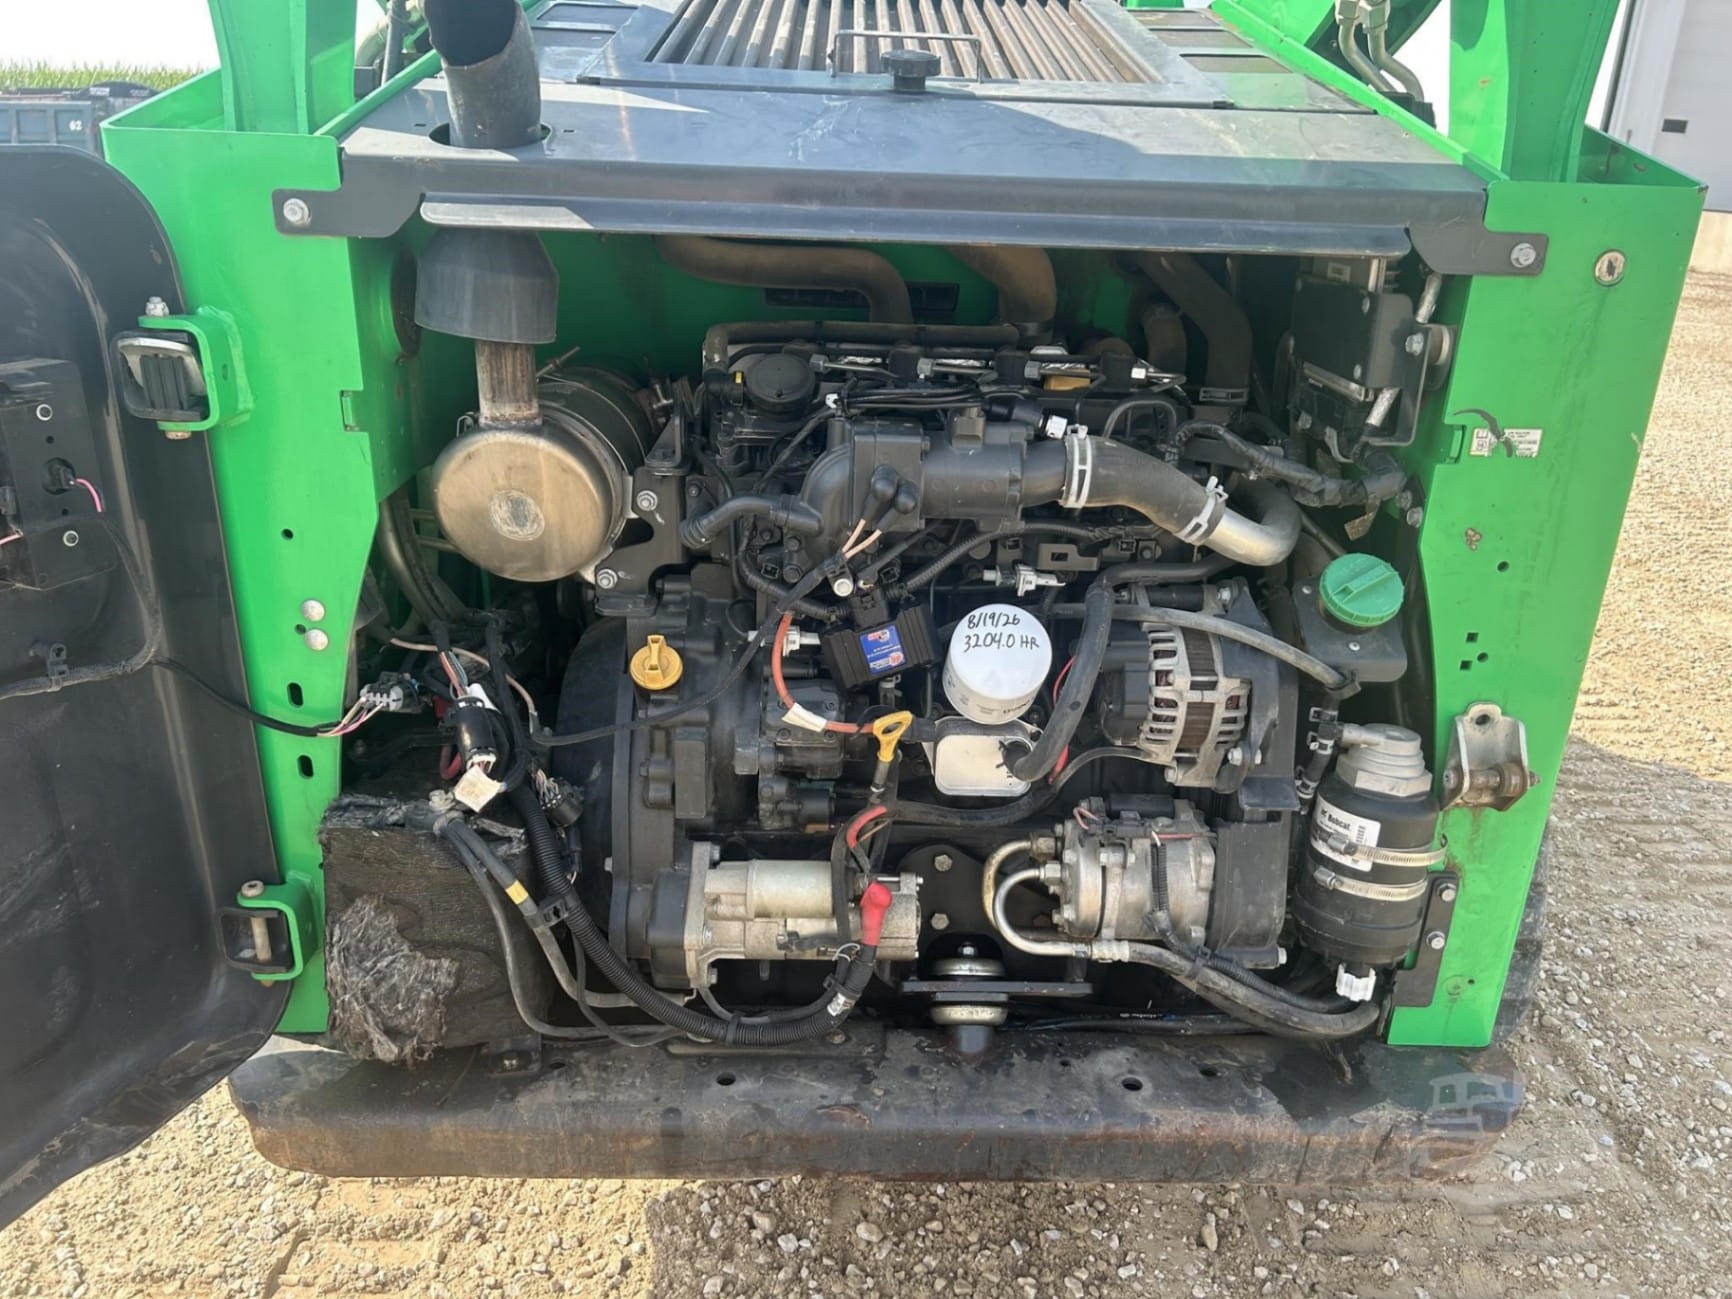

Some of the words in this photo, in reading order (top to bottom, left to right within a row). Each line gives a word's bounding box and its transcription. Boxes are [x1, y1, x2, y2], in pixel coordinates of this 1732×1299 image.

[967, 612, 1020, 630] 8/19/26
[963, 632, 1016, 653] 3204.0
[1020, 635, 1040, 650] HR
[1327, 813, 1351, 831] Bobcat
